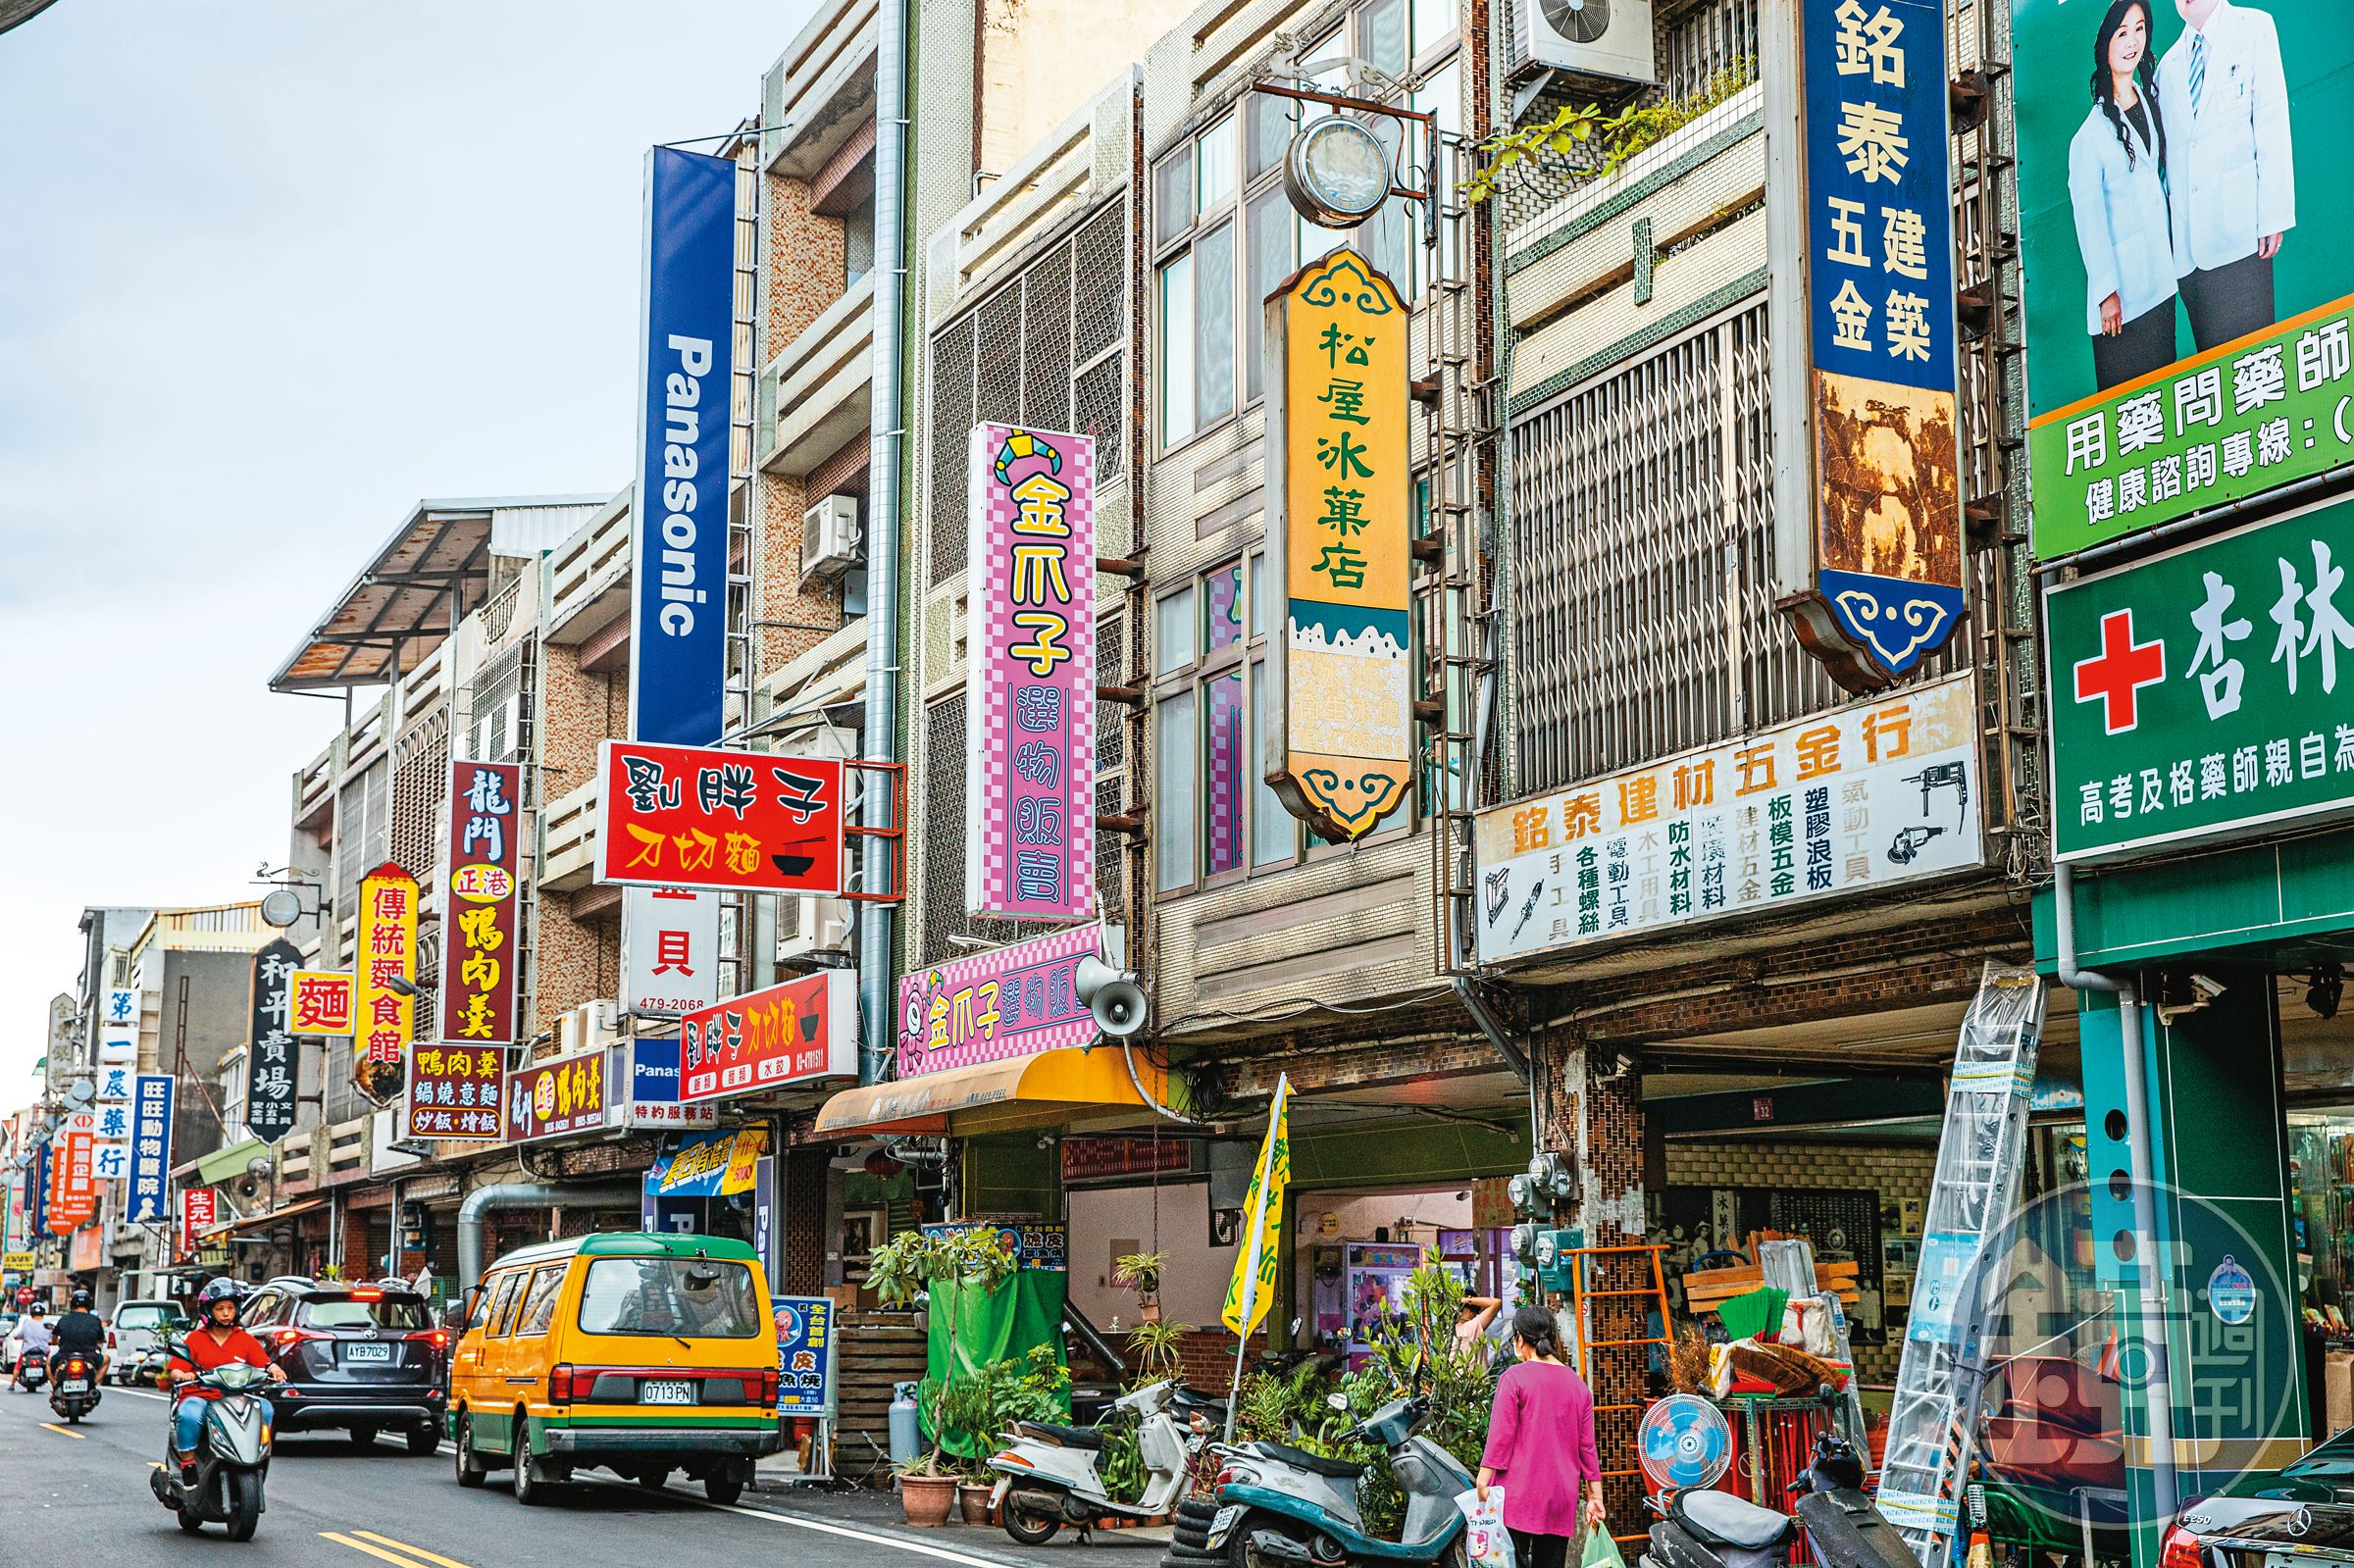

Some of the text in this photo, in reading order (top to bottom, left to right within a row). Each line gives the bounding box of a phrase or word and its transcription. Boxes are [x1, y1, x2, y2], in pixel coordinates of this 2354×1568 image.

[1834, 0, 1910, 186] 銘泰
[1826, 195, 1873, 353] 五金
[1881, 205, 1932, 364] 建築
[2064, 316, 2352, 478] 用藥問藥師
[659, 333, 714, 637] Panasonic
[1311, 322, 1376, 589] 松屋冰菓店
[1008, 472, 1073, 677] 金爪子
[2185, 538, 2354, 722] 杏林
[462, 767, 511, 864] 龍門
[621, 754, 829, 825] 劉胖子
[1013, 683, 1062, 903] 選物販賣
[1511, 703, 1912, 854] 銘泰建材五金行
[625, 823, 762, 876] 刀切麵
[1638, 831, 1661, 923] 木工用具
[1668, 820, 1693, 916] 防水材料
[1736, 805, 1762, 904] 建材五金
[1768, 793, 1795, 897] 板模五金
[1805, 786, 1832, 891] 塑膠浪板
[1841, 779, 1871, 884] 氣動工具
[458, 869, 509, 897] 正港
[1576, 845, 1600, 935] 各種螺絲
[1607, 836, 1630, 929] 電動工具
[296, 977, 349, 1030] 麵
[367, 887, 408, 1063] 傳統麵食館
[457, 906, 505, 1038] 鴨肉羹
[640, 996, 704, 1011] 479-2068
[928, 980, 1001, 1051] 金爪子
[1001, 961, 1087, 1028] 選物販
[254, 953, 299, 1100] 和平賣場
[417, 1048, 500, 1079] 鴨肉羹
[635, 1063, 681, 1078] Panas
[686, 1009, 743, 1071] 劉胖子
[746, 996, 795, 1056] 刀切麵
[764, 1059, 785, 1077] 水餃
[98, 991, 132, 1177] 第一農藥行
[265, 1101, 279, 1125] 小五金
[415, 1081, 498, 1107] 鍋燒意麵
[557, 1055, 601, 1117] 鴨肉羹
[635, 1104, 714, 1121] 特約服務站
[136, 1081, 166, 1196] 旺旺動物醫院
[807, 1303, 827, 1348] 全台首創
[779, 1372, 822, 1390] 魚燒
